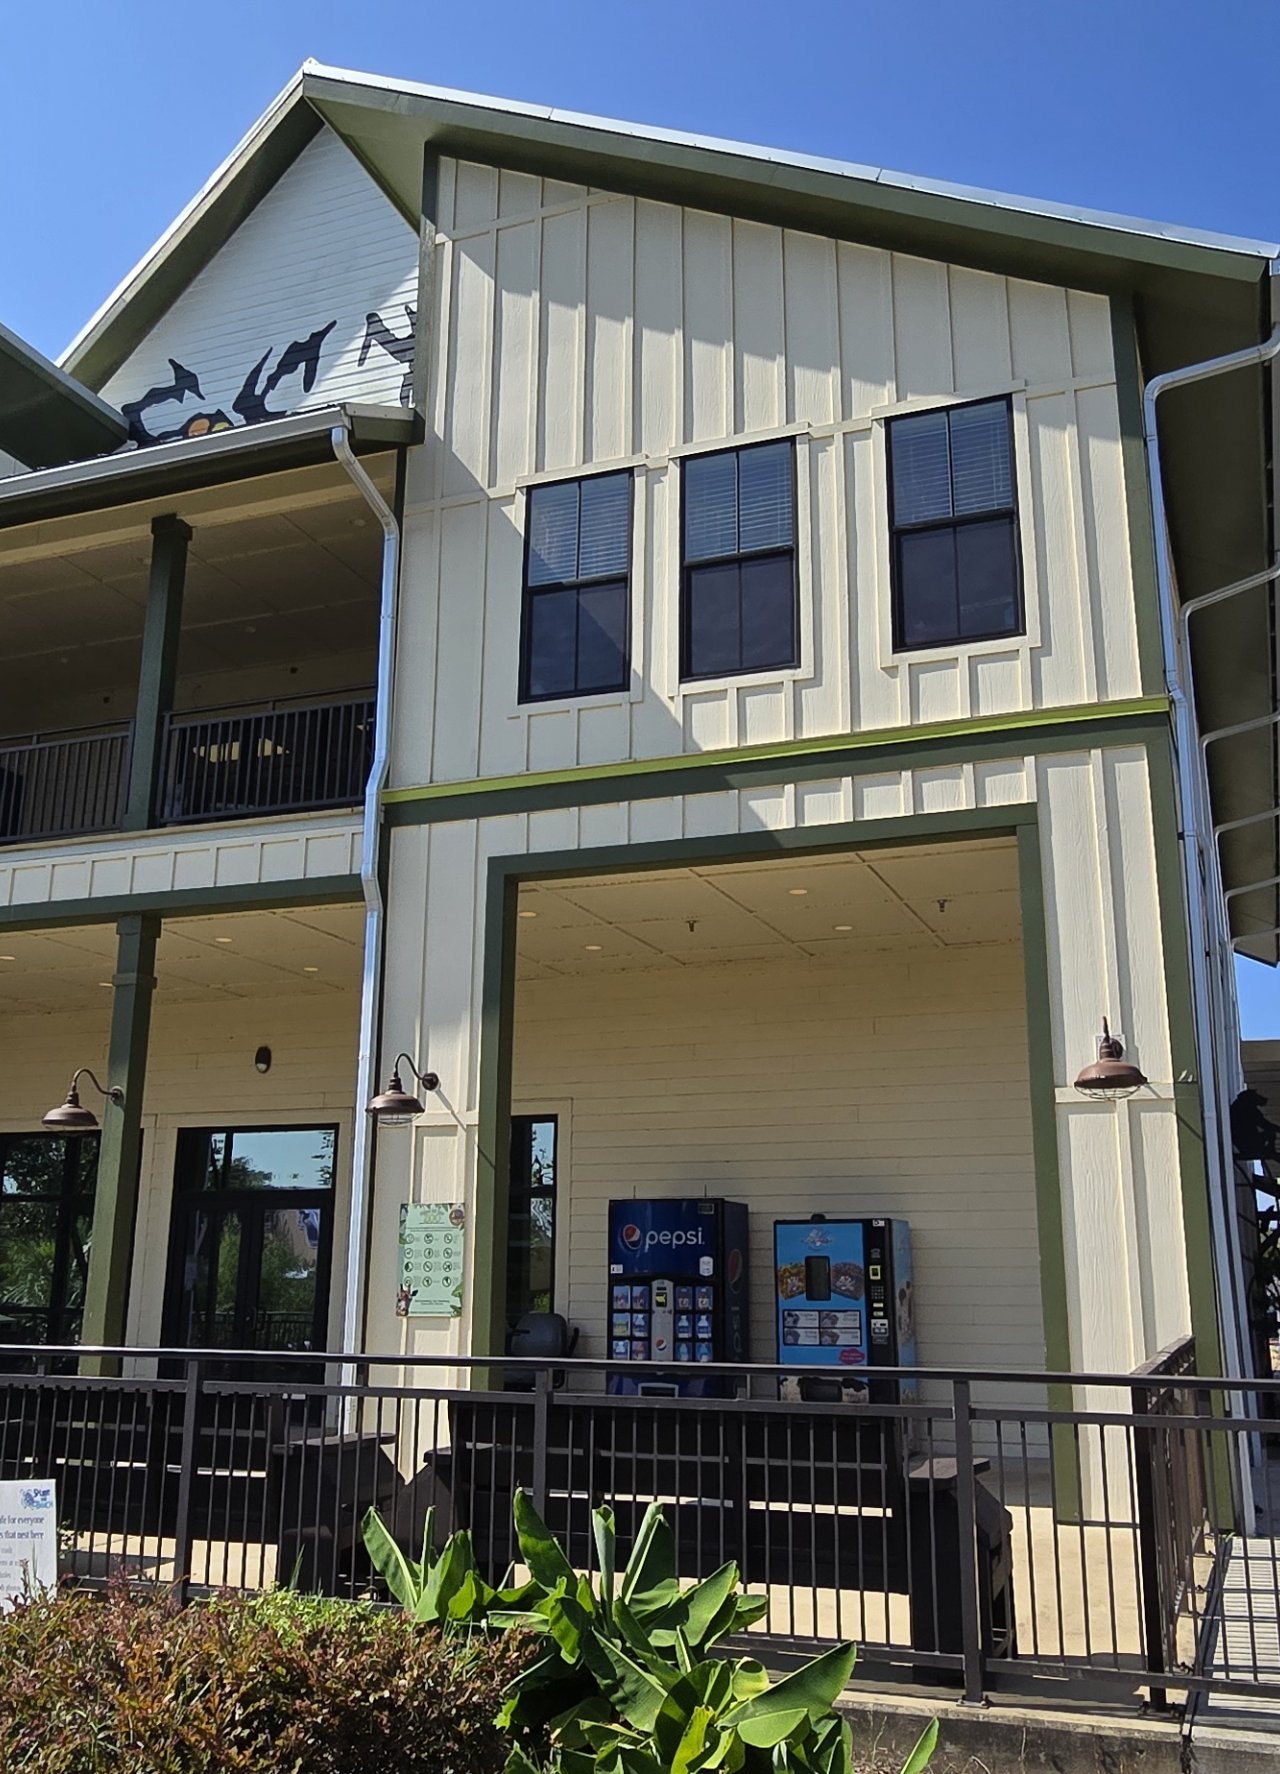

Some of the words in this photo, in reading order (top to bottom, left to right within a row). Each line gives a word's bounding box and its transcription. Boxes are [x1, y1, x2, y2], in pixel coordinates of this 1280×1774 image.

[644, 1227, 703, 1253] pepsi
[7, 1515, 17, 1524] for
[17, 1516, 44, 1526] everyone
[4, 1530, 16, 1539] that
[17, 1531, 29, 1539] nest
